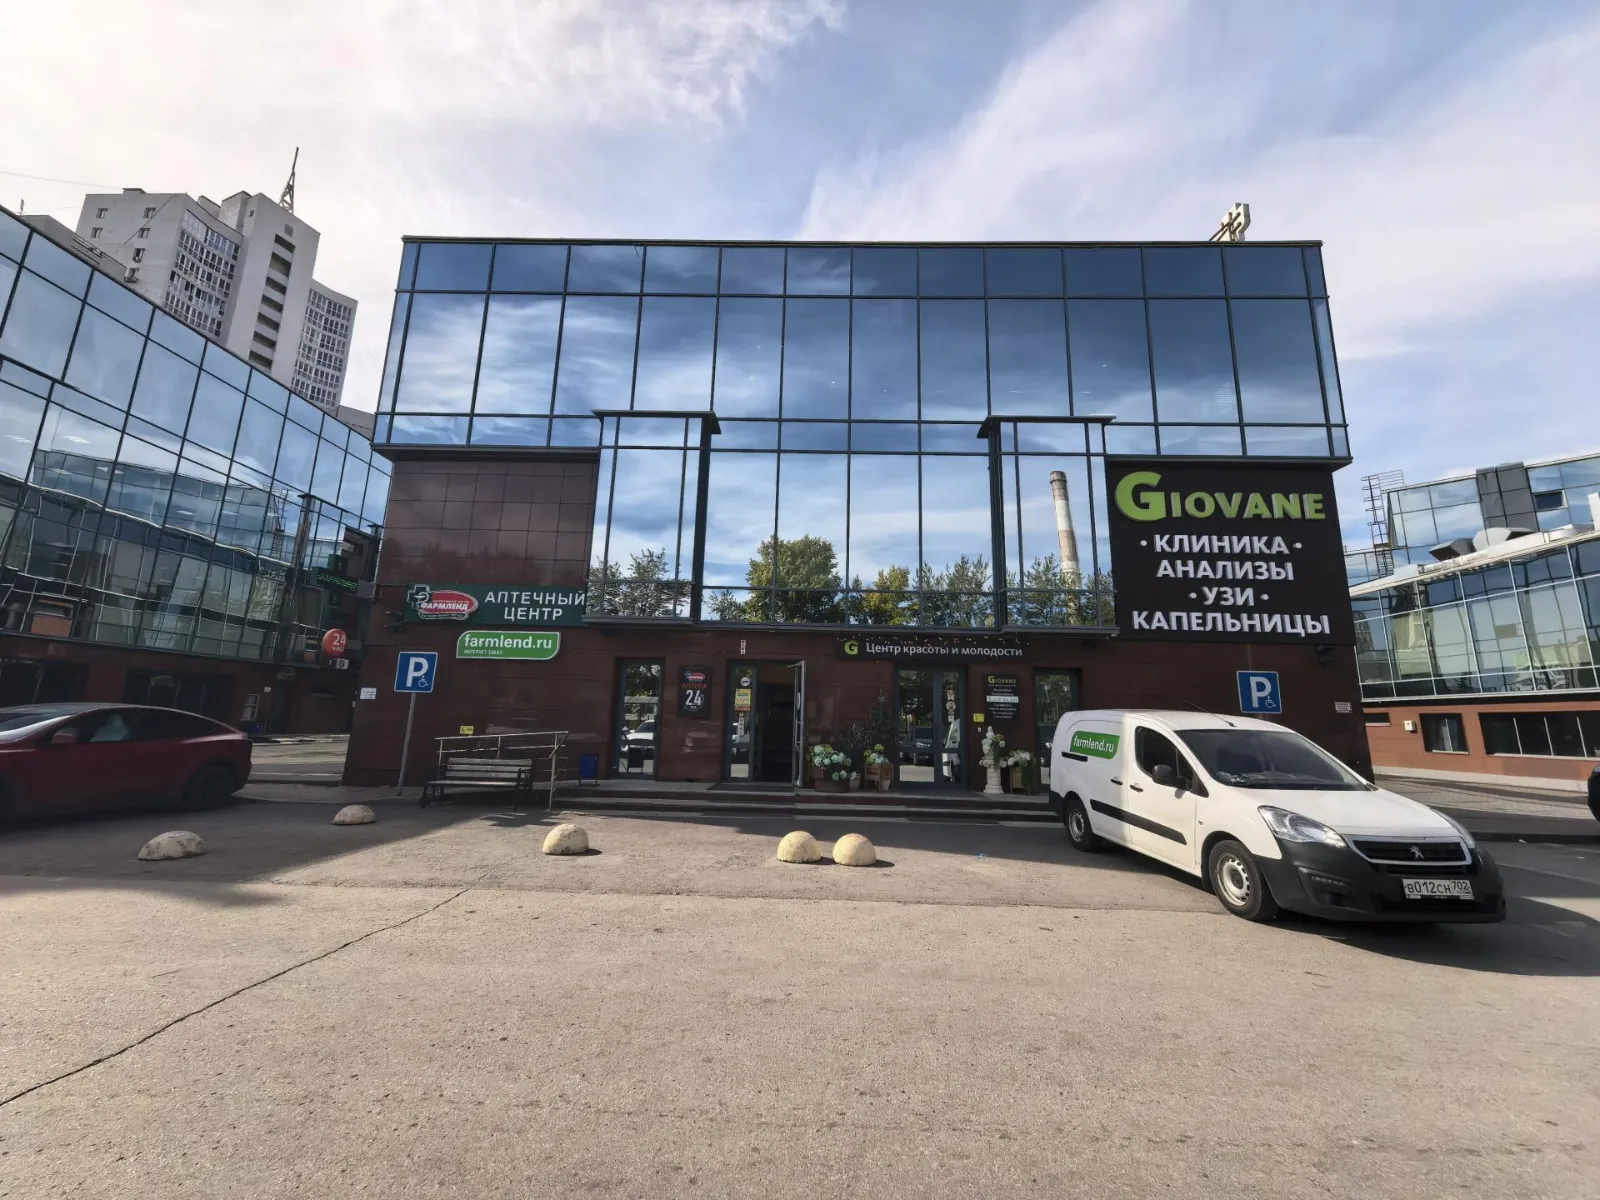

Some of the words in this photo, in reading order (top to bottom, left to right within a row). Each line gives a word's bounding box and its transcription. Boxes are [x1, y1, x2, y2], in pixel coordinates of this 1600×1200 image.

[1115, 471, 1326, 521] GIOVANE
[1153, 534, 1290, 554] КЛИНИКА
[1156, 560, 1294, 581] АНАЛИЗЫ
[484, 590, 586, 606] АПТЕЧНЫЙ
[1202, 586, 1255, 606] УЗИ
[420, 602, 468, 610] ФАРМЛЕНД
[504, 607, 563, 622] ЦЕНТР
[1132, 610, 1331, 637] КАПЕЛЬНИЦЫ
[332, 633, 346, 646] 24
[464, 634, 552, 649] farmlend.ru
[844, 640, 859, 655] G
[865, 643, 901, 656] Центр
[903, 645, 949, 655] красоты
[951, 647, 959, 655] и
[961, 646, 1023, 657] молодости
[406, 657, 429, 687] P
[685, 689, 702, 706] 24
[1250, 676, 1272, 708] P
[1073, 735, 1114, 752] farmlend.ru
